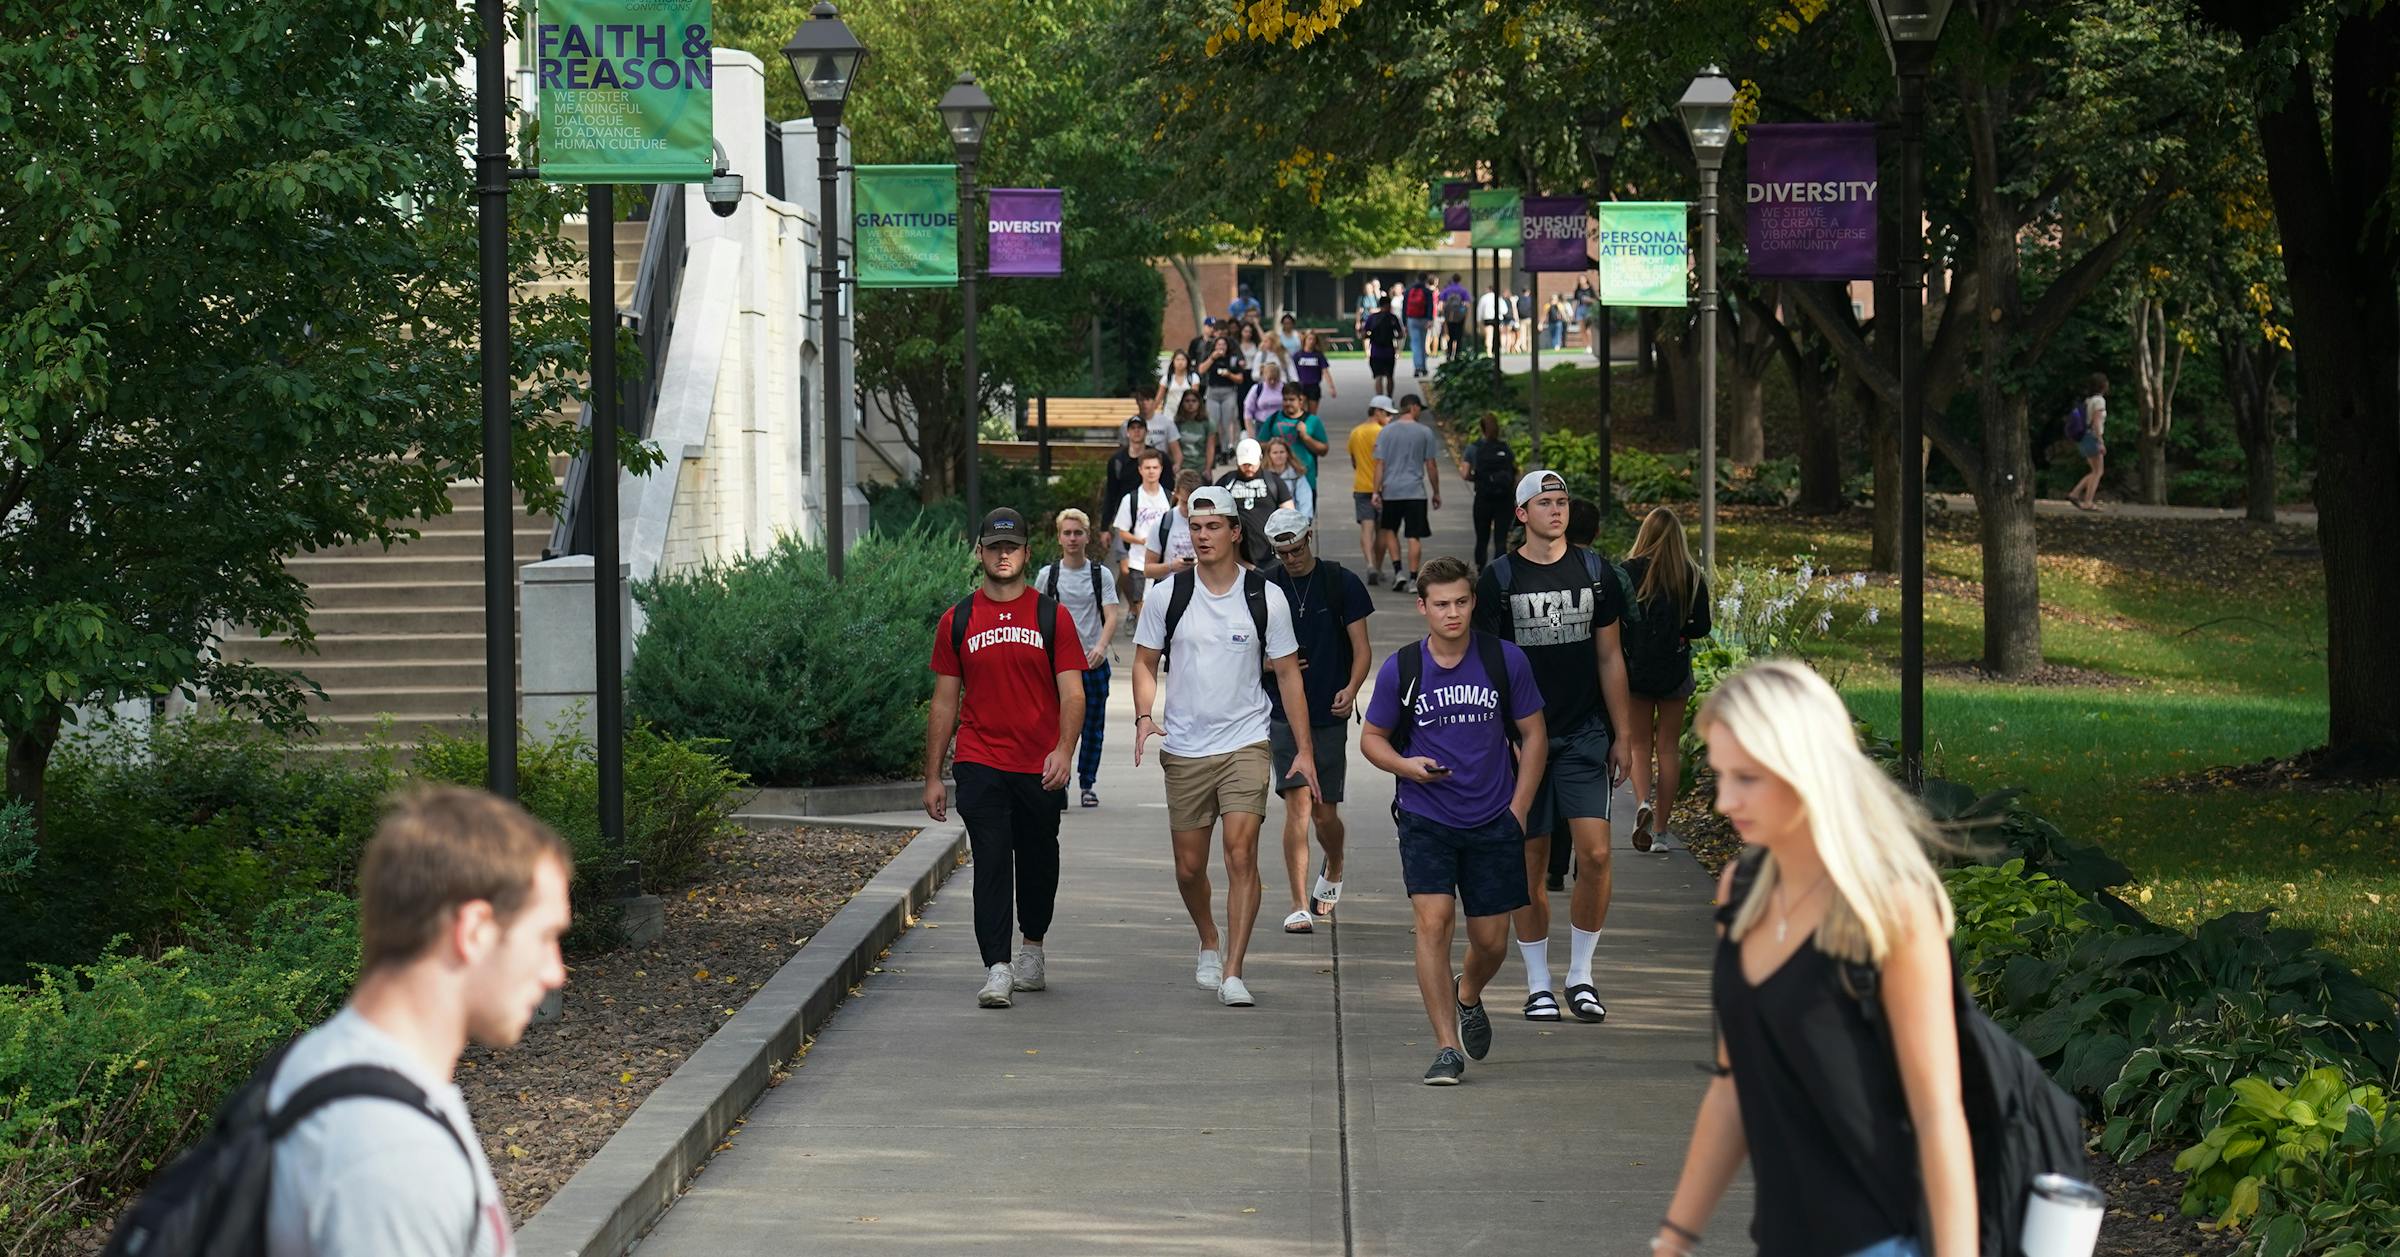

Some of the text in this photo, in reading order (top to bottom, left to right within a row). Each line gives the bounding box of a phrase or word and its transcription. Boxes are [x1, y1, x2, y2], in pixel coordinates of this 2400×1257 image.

[539, 24, 712, 59] FAITH &
[539, 58, 712, 90] REASON
[554, 91, 629, 102] WE FOSTER
[554, 103, 642, 114] MEANINGFUL
[554, 115, 623, 126] DIALOGUE
[554, 126, 641, 138] TO ADVANCE
[554, 138, 667, 150] HUMAN CULTURE
[1747, 181, 1877, 203] DIVERSITY
[1761, 206, 1823, 217] WE STRIVE
[856, 213, 957, 227] GRATITUDE
[1523, 216, 1586, 228] PURSUIT
[1761, 217, 1839, 228] TO CREATE A
[988, 220, 1062, 233] DIVERSITY
[1523, 227, 1587, 239] OF TRUTH
[1601, 231, 1686, 243] PERSONAL
[1761, 228, 1866, 239] VIBRANT DIVERSE
[1601, 244, 1687, 256] ATTENTION
[1761, 240, 1839, 250] COMMUNITY
[1509, 587, 1595, 619] NY2LA
[967, 626, 1044, 653] WISCONSIN
[1434, 685, 1499, 709] THOMAS
[1443, 712, 1495, 724] TOMMIES
